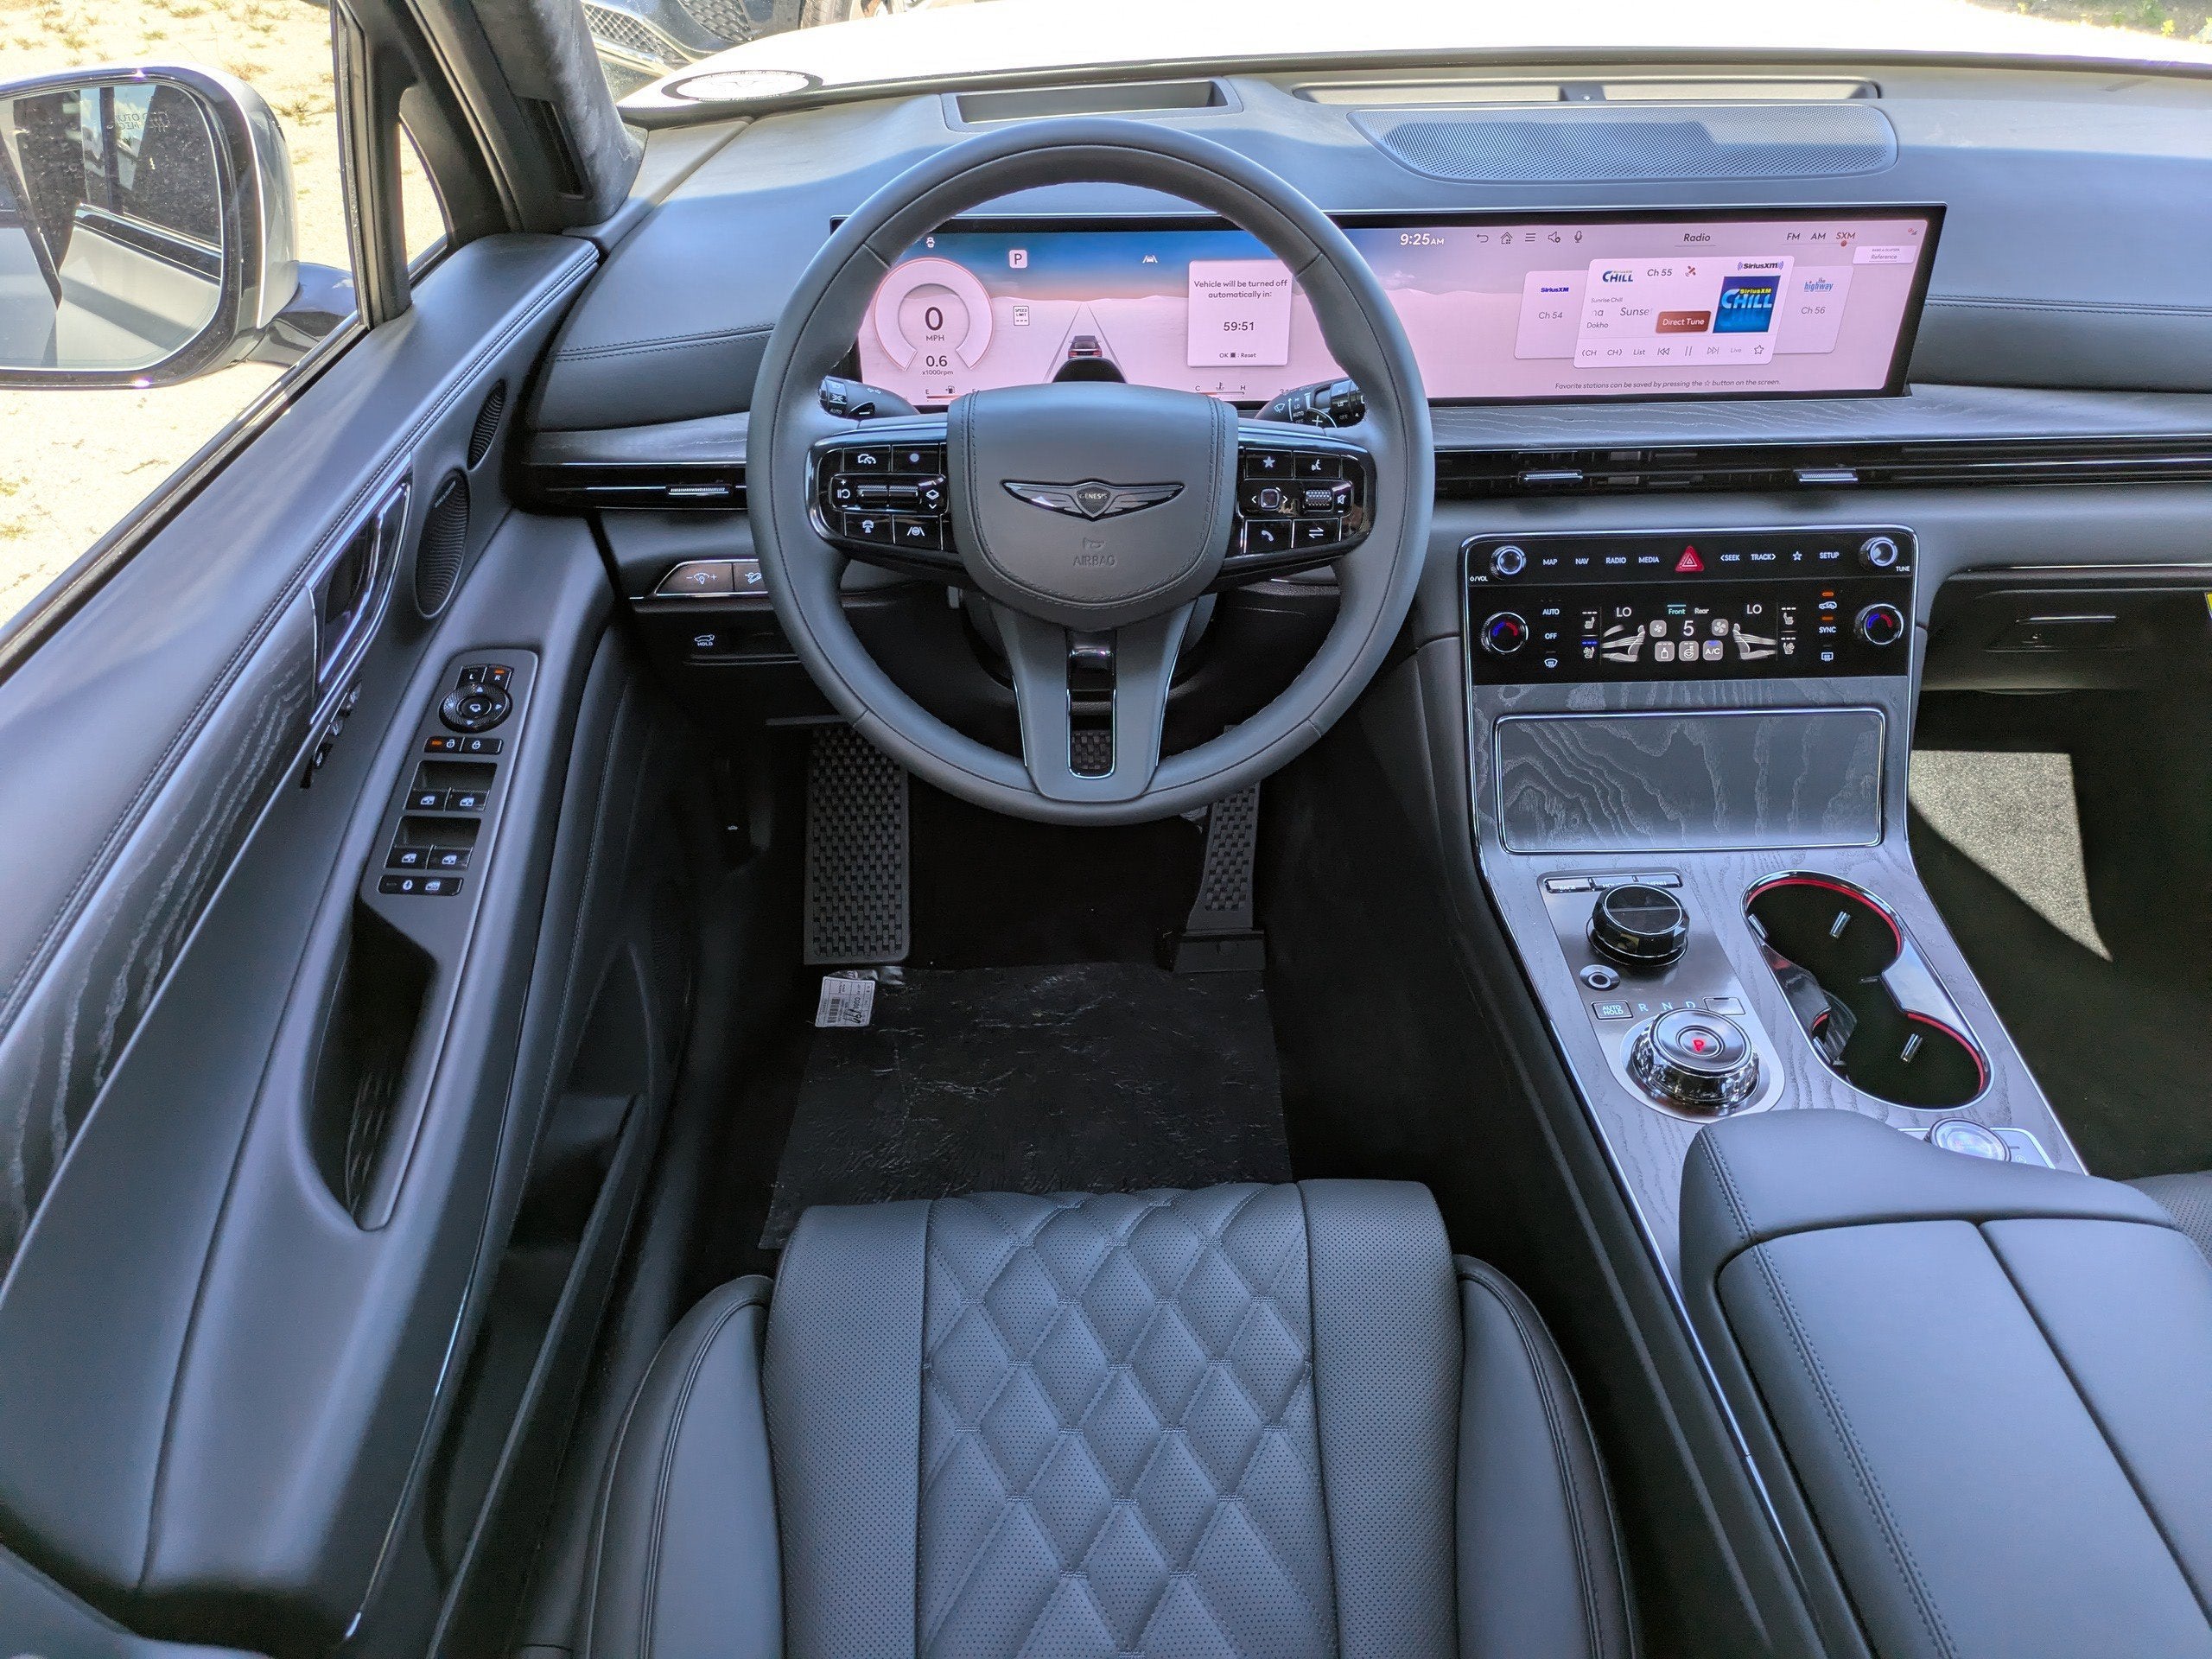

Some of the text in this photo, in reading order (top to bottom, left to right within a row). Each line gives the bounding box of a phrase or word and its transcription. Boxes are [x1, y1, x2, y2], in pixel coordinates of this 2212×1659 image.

[1684, 232, 1710, 243] Radio
[1014, 253, 1022, 264] P
[1603, 270, 1633, 283] CHILL
[1804, 281, 1834, 292] highway
[1721, 289, 1772, 308] CHILL
[925, 307, 944, 331] 0
[1224, 321, 1255, 331] 59:51
[925, 355, 948, 367] 0.6
[1073, 555, 1116, 567] AIRBAG
[1616, 607, 1631, 617] LO
[1746, 605, 1762, 613] LO
[1683, 620, 1694, 637] 5
[1694, 1039, 1704, 1052] P
